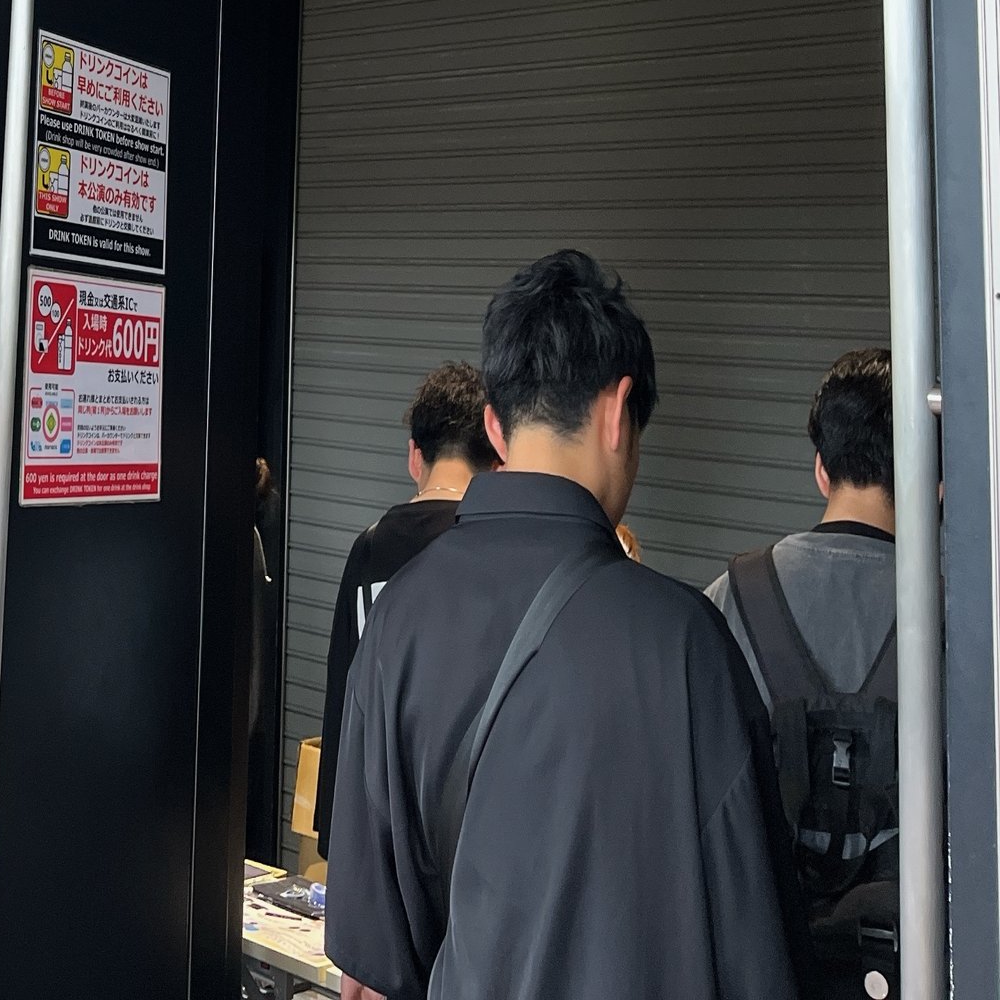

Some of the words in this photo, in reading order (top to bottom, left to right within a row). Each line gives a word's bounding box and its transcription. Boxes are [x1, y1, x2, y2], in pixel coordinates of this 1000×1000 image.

[80, 51, 149, 89] ドリンクコインは
[77, 76, 164, 116] 早めにご利用ください
[40, 114, 60, 130] Please
[61, 122, 73, 132] use
[73, 123, 94, 137] DRINK
[95, 128, 115, 142] TOKEN
[116, 134, 134, 148] before
[134, 138, 149, 151] show
[149, 143, 165, 156] start.
[45, 132, 61, 143] (Drink
[62, 136, 74, 146] shop
[75, 138, 84, 148] will
[84, 140, 91, 149] be
[91, 143, 102, 154] very
[103, 143, 123, 158] crowded
[123, 150, 135, 161] after
[135, 153, 147, 164] show
[147, 156, 160, 168] end.)
[80, 155, 149, 188] ドリンクコインは
[45, 203, 59, 212] ONLY
[78, 180, 156, 213] 本公演のみ有効です
[48, 228, 70, 242] DRINK
[71, 232, 92, 246] TOKEN
[92, 236, 98, 246] is
[99, 237, 113, 249] valid
[114, 240, 123, 251] for
[123, 241, 134, 253] this
[135, 245, 151, 256] show.
[40, 295, 51, 307] 500
[52, 309, 60, 318] 100
[79, 290, 138, 312] 現金又は交通系ICで
[83, 313, 108, 332] 入場時
[78, 336, 112, 358] ドリンク代
[112, 318, 159, 363] 600円
[107, 369, 159, 385] お支払いください
[25, 473, 37, 483] 600
[38, 475, 49, 485] yen
[50, 472, 55, 483] is
[56, 472, 80, 485] required
[80, 472, 86, 482] at
[87, 472, 96, 481] the
[96, 472, 109, 481] door
[110, 473, 116, 481] as
[117, 473, 126, 481] one
[127, 470, 140, 480] drink
[141, 470, 158, 482] charge
[50, 486, 69, 495] exchange
[70, 485, 83, 493] DRINK
